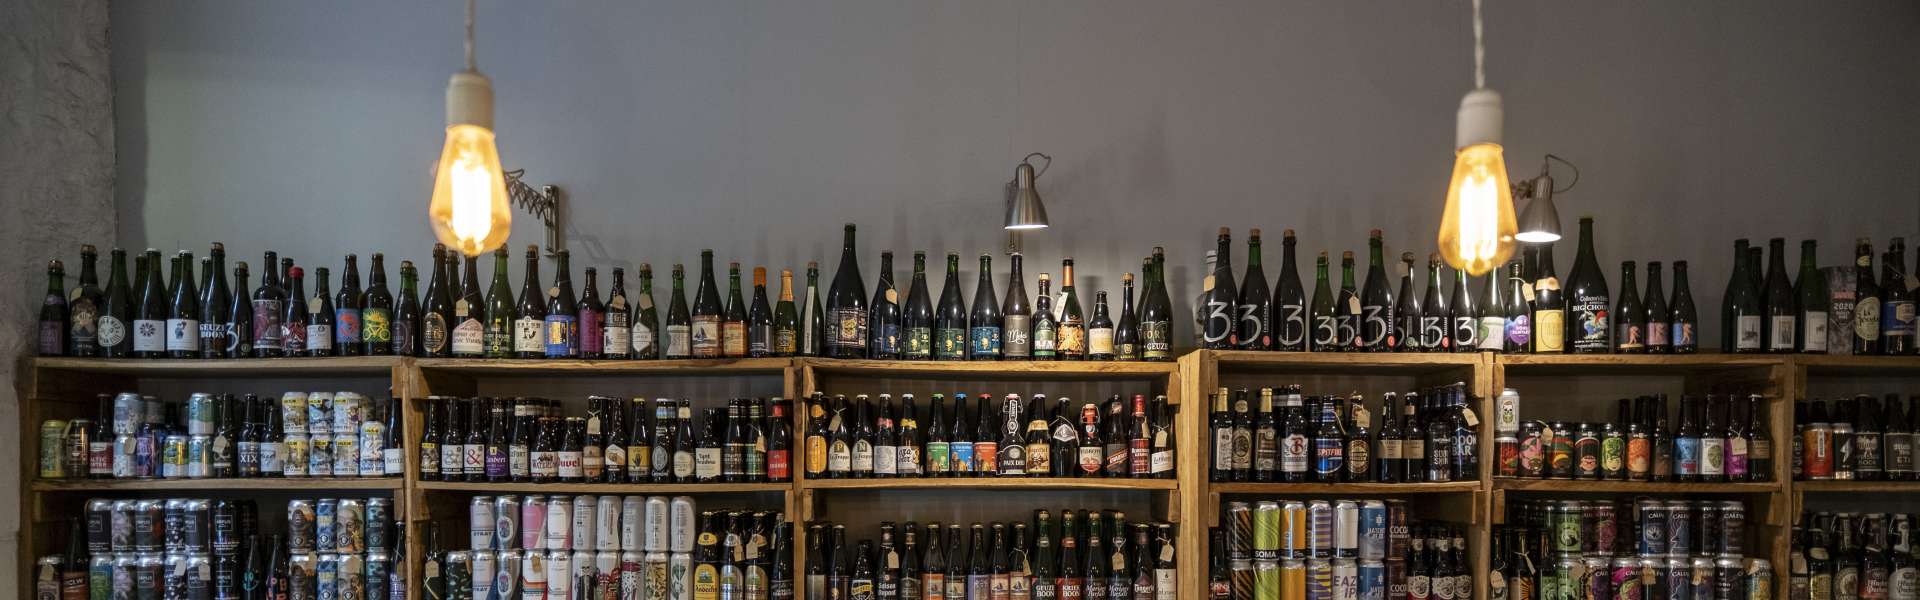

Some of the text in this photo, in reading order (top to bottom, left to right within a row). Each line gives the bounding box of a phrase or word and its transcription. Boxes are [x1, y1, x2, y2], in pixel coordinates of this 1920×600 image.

[1833, 302, 1854, 310] 2020
[1452, 434, 1477, 446] DOOM
[1452, 445, 1472, 456] BAR
[240, 454, 258, 463] XIX
[559, 457, 581, 468] uvel
[1254, 550, 1276, 558] SOMA
[1333, 575, 1357, 586] EAZ
